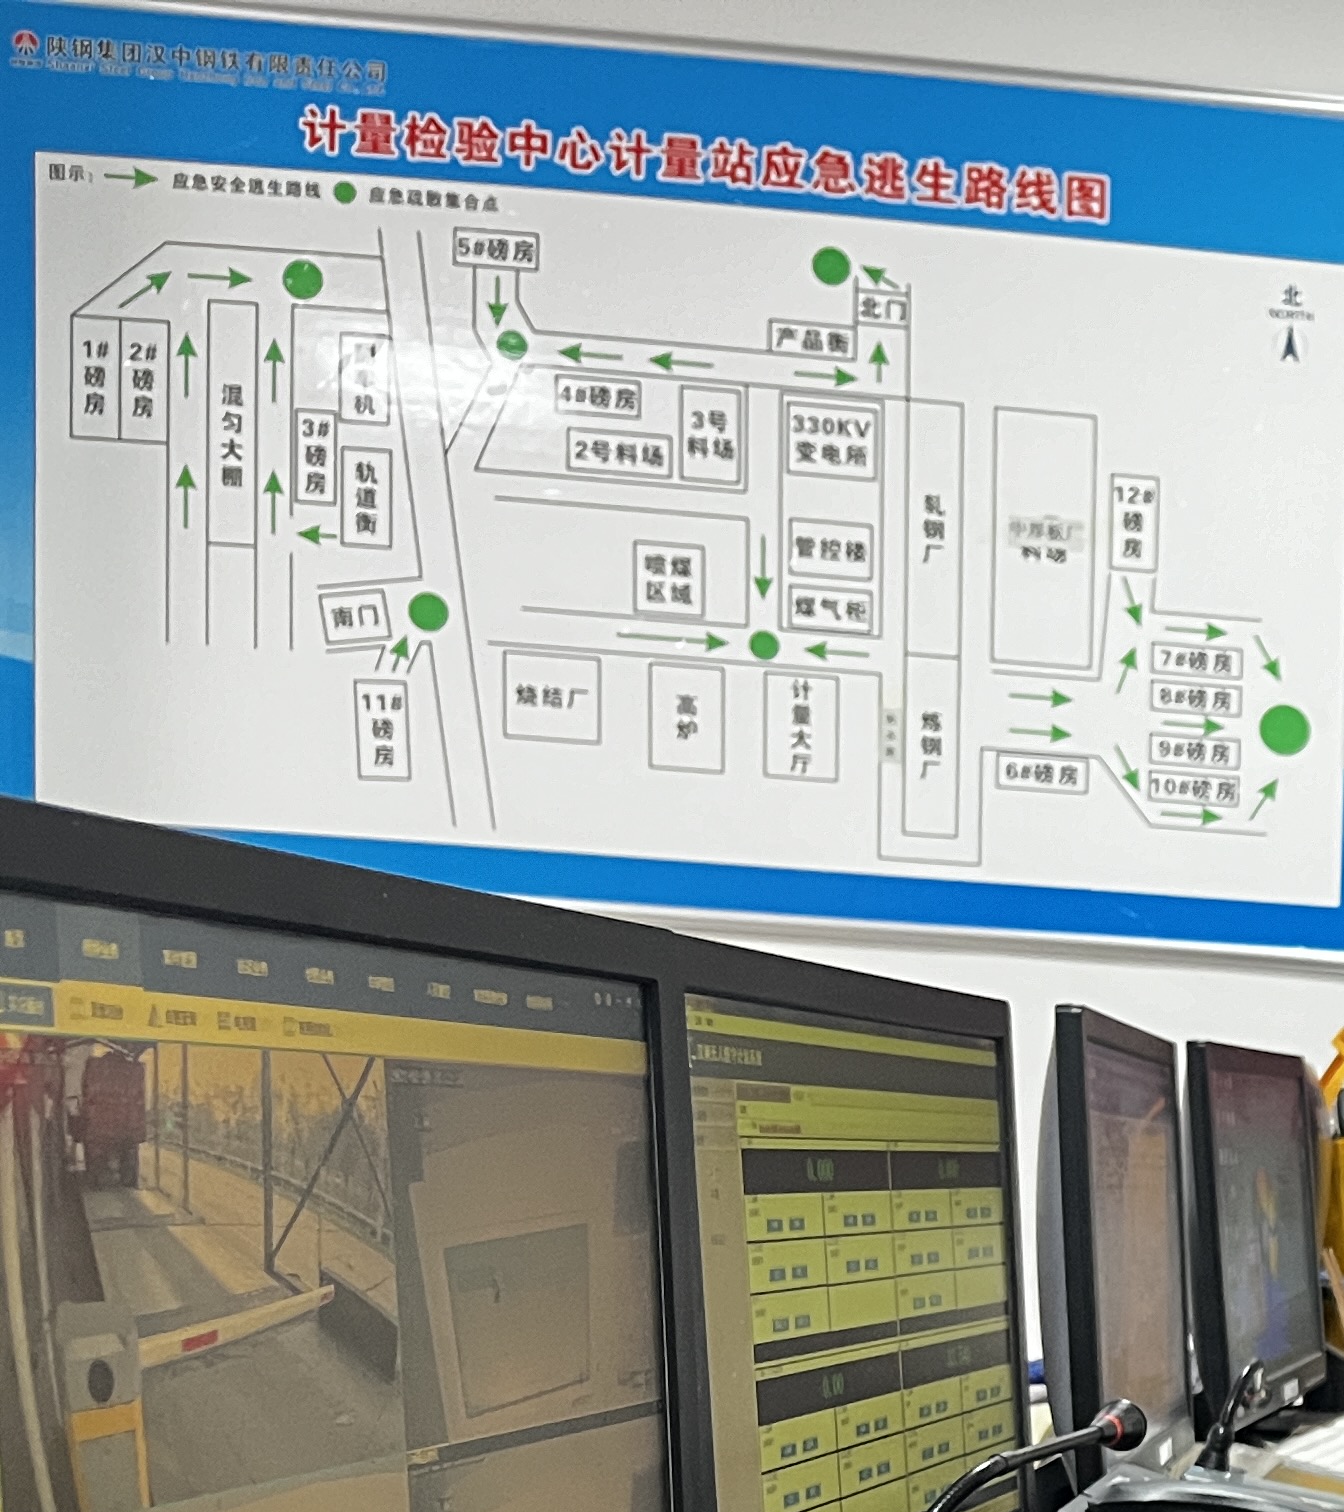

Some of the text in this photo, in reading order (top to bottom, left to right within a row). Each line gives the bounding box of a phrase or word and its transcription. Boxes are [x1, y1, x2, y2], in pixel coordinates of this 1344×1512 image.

[47, 36, 387, 82] 陕钢集团汉中钢铁有限责任公司
[301, 105, 1110, 223] 计量检验中心计量站应急逃生路线图
[457, 237, 535, 264] 5#磅房
[860, 296, 908, 322] 北门
[574, 440, 666, 468] 2号料场
[331, 602, 381, 629] 南门
